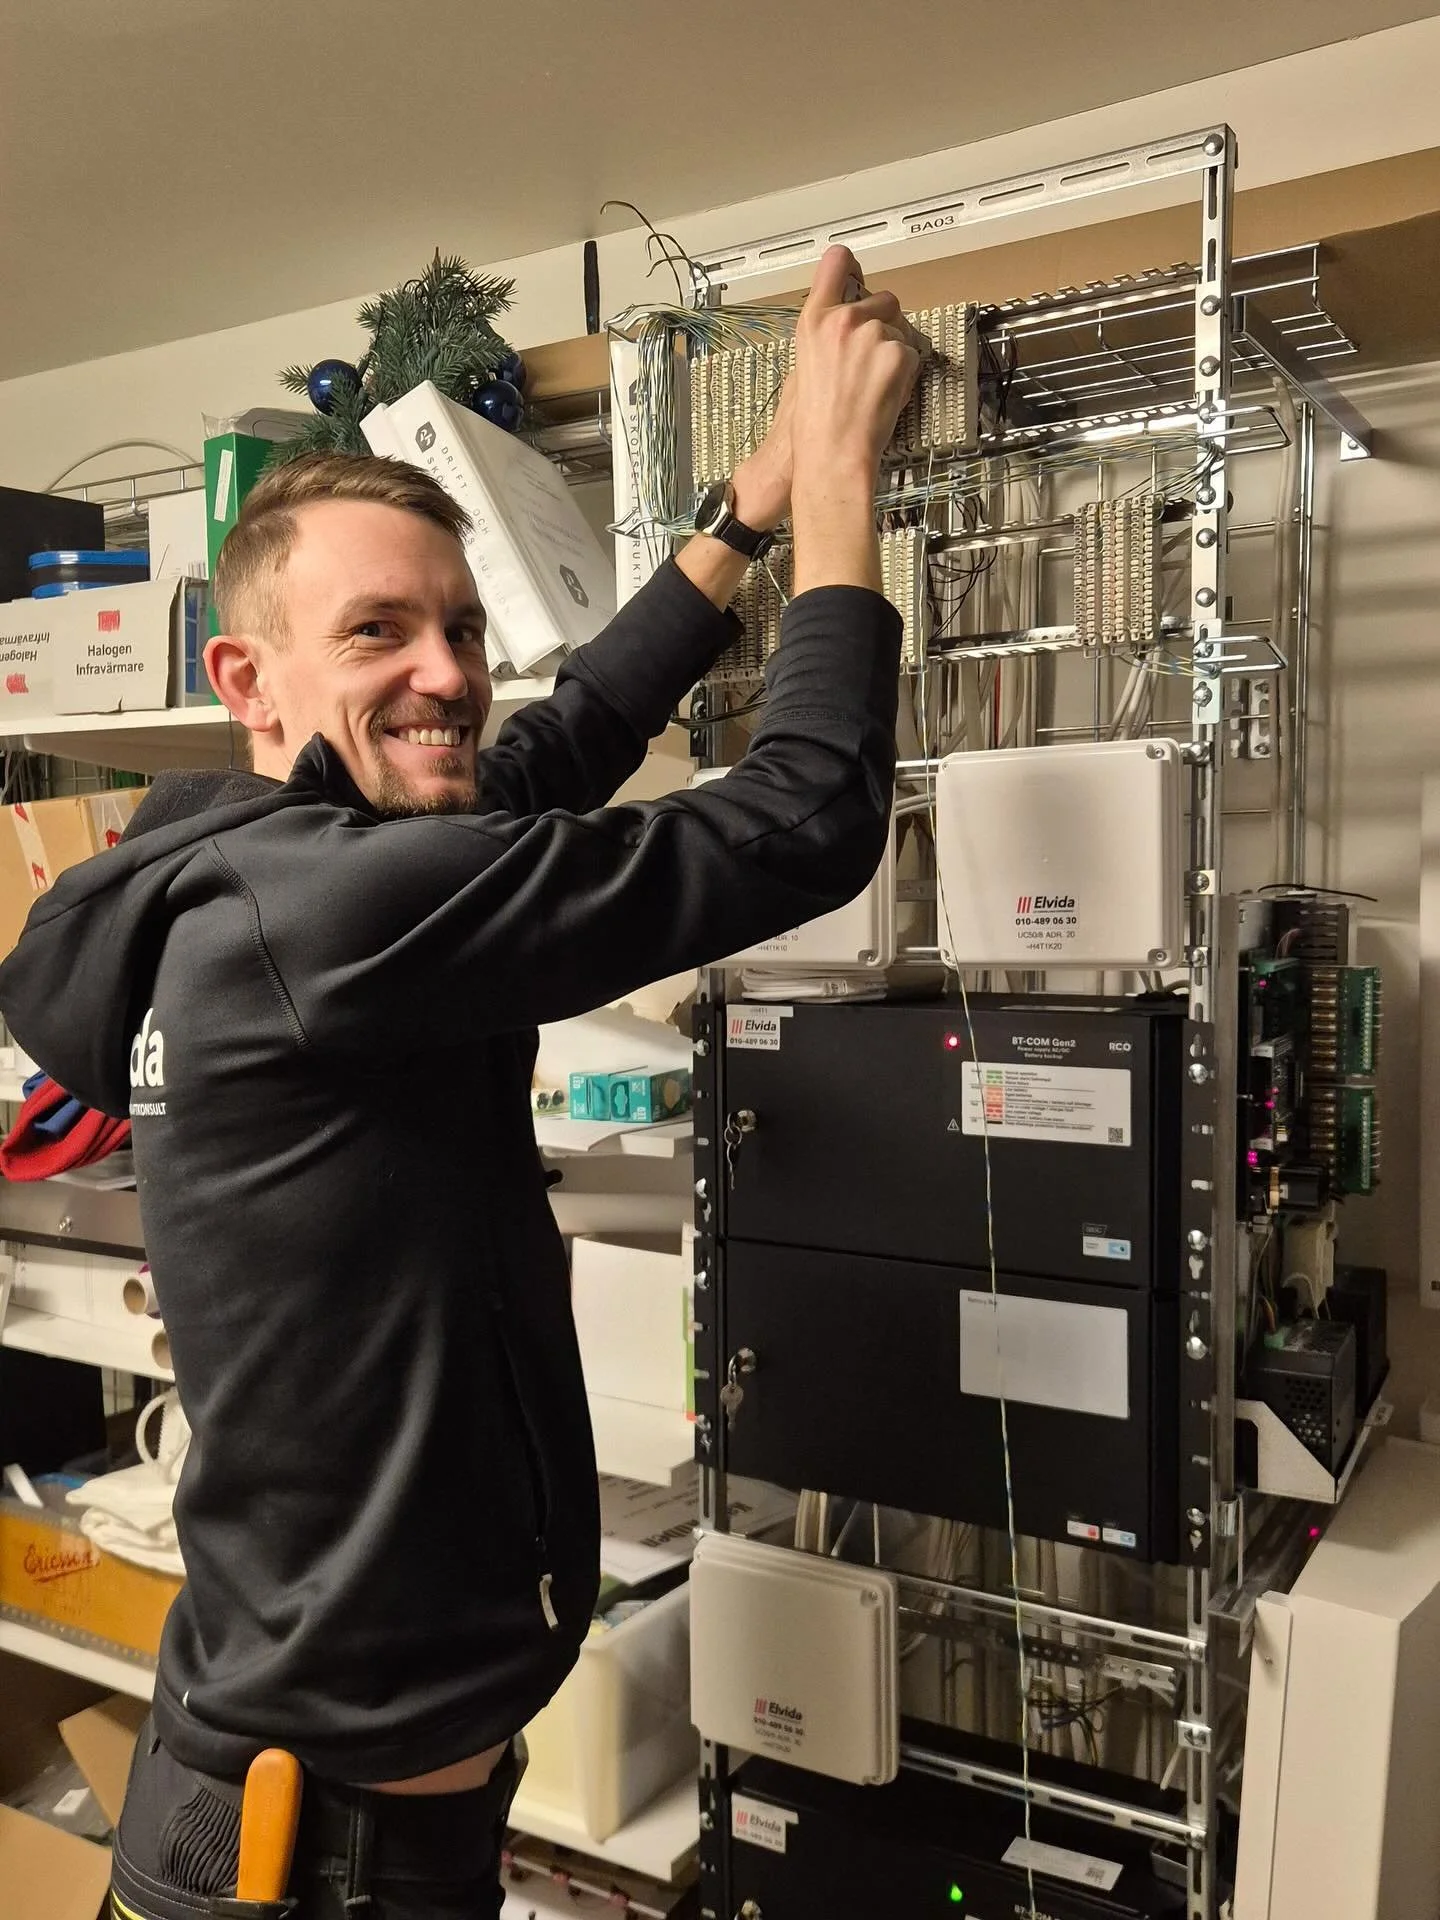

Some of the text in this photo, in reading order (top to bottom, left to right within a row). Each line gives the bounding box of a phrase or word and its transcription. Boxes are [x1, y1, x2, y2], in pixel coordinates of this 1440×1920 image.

[911, 216, 954, 233] BA03
[87, 645, 132, 658] Halogen
[76, 661, 144, 676] Infravärmare
[1034, 895, 1075, 909] Elvida
[1015, 916, 1077, 926] 010-489 06 30
[1066, 930, 1076, 938] 20
[745, 1019, 776, 1031] Elvida
[130, 1007, 164, 1087] da
[1012, 1036, 1077, 1048] BT-COM Gen2
[1109, 1042, 1132, 1052] RCO
[769, 1702, 803, 1720] Elvida
